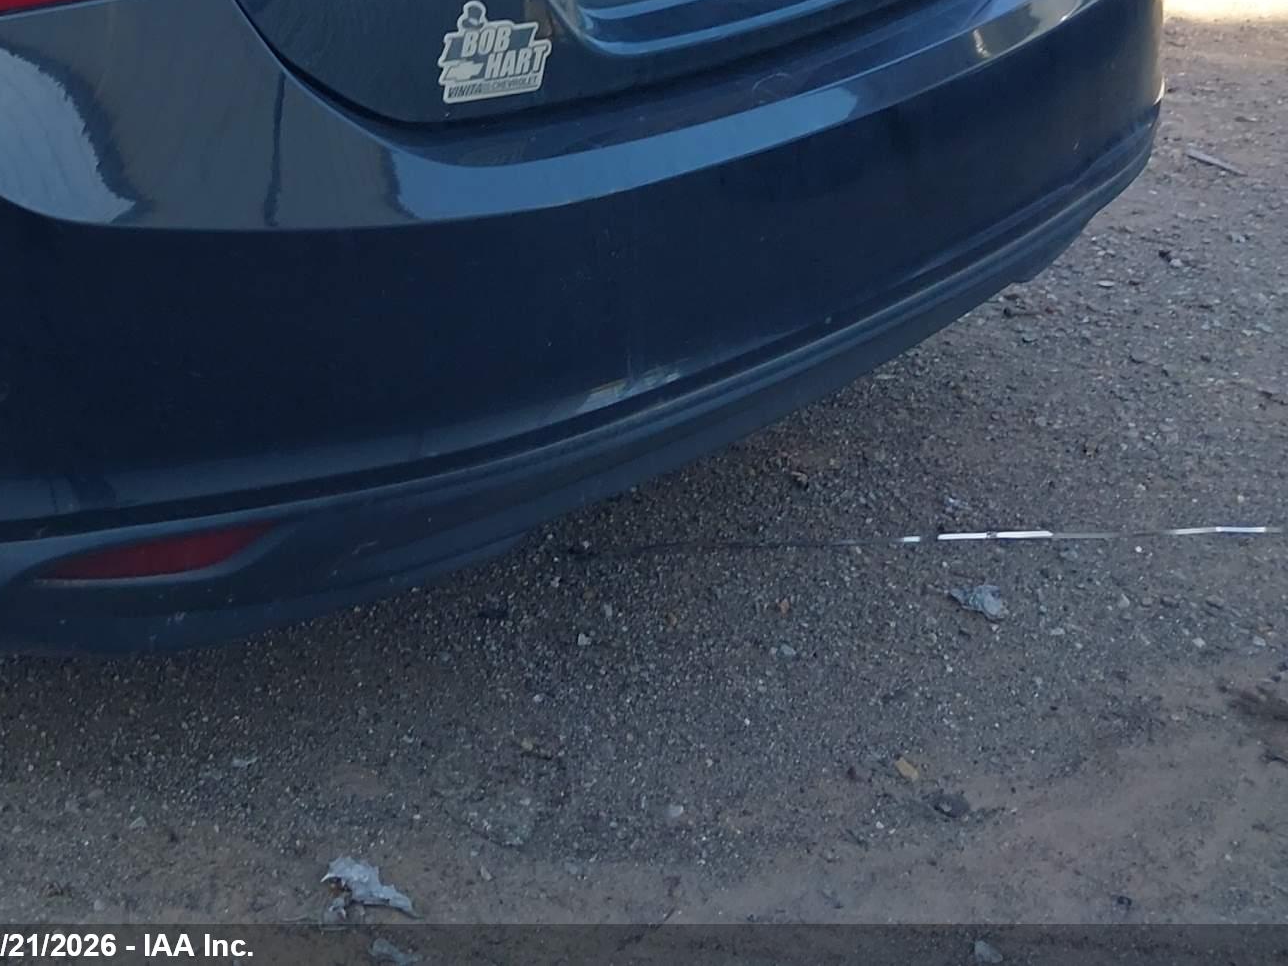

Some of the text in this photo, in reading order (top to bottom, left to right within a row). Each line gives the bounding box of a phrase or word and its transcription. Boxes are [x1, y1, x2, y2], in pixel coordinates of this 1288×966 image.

[462, 27, 511, 58] BOB
[485, 46, 546, 79] HART
[448, 82, 483, 99] VINITA
